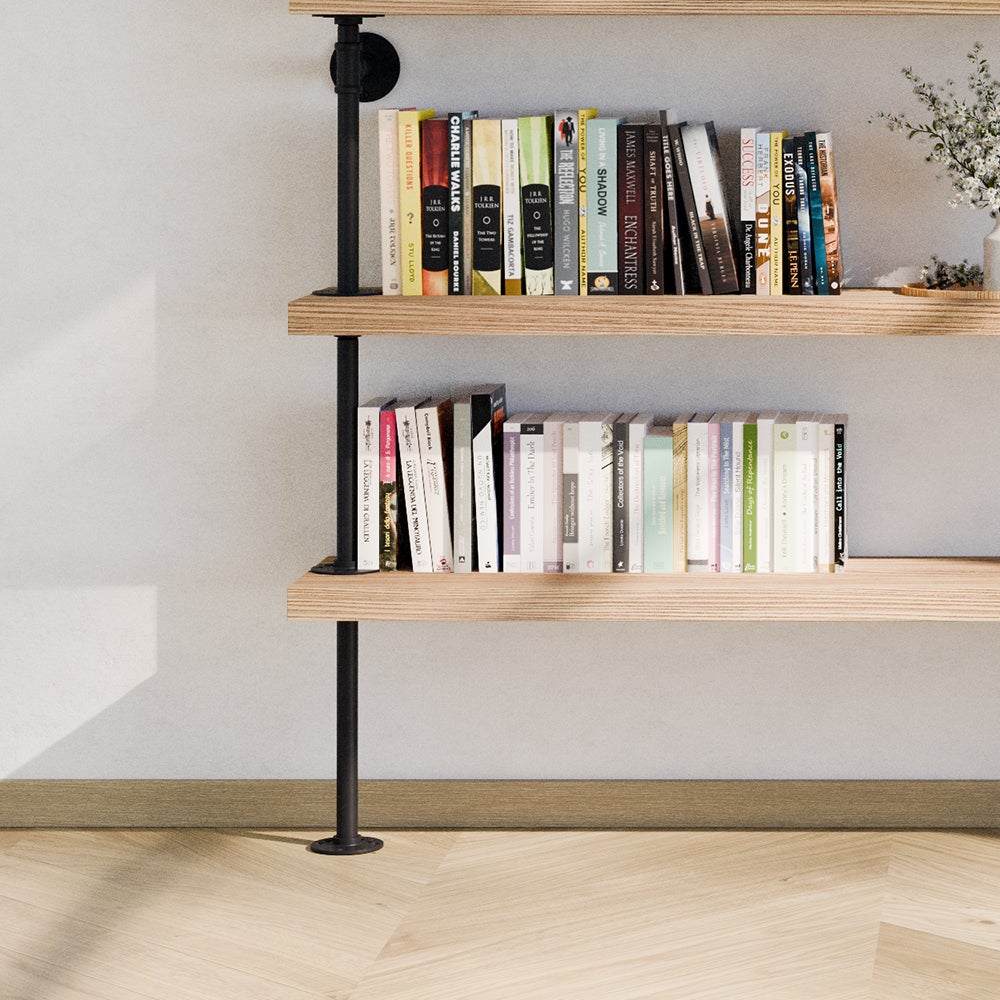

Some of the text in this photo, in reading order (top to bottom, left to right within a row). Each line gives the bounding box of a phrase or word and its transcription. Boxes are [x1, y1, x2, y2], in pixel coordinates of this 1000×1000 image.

[405, 152, 413, 190] QUESTIONS
[451, 116, 460, 212] CHARLIE WALKS
[559, 150, 574, 204] THE REFLECTION
[626, 131, 636, 204] JAMES MAXWELL
[664, 157, 672, 179] GOES
[742, 139, 754, 187] SUCCESS
[783, 153, 795, 195] EXODUS
[597, 169, 607, 216] SHADOW
[507, 227, 515, 277] GAMBACORTA
[624, 215, 637, 289] ENCHANTRESS
[744, 234, 752, 251] Angele
[758, 204, 769, 257] DUNE
[745, 253, 753, 288] Charbonneau
[364, 460, 369, 468] LA
[747, 486, 754, 494] of
